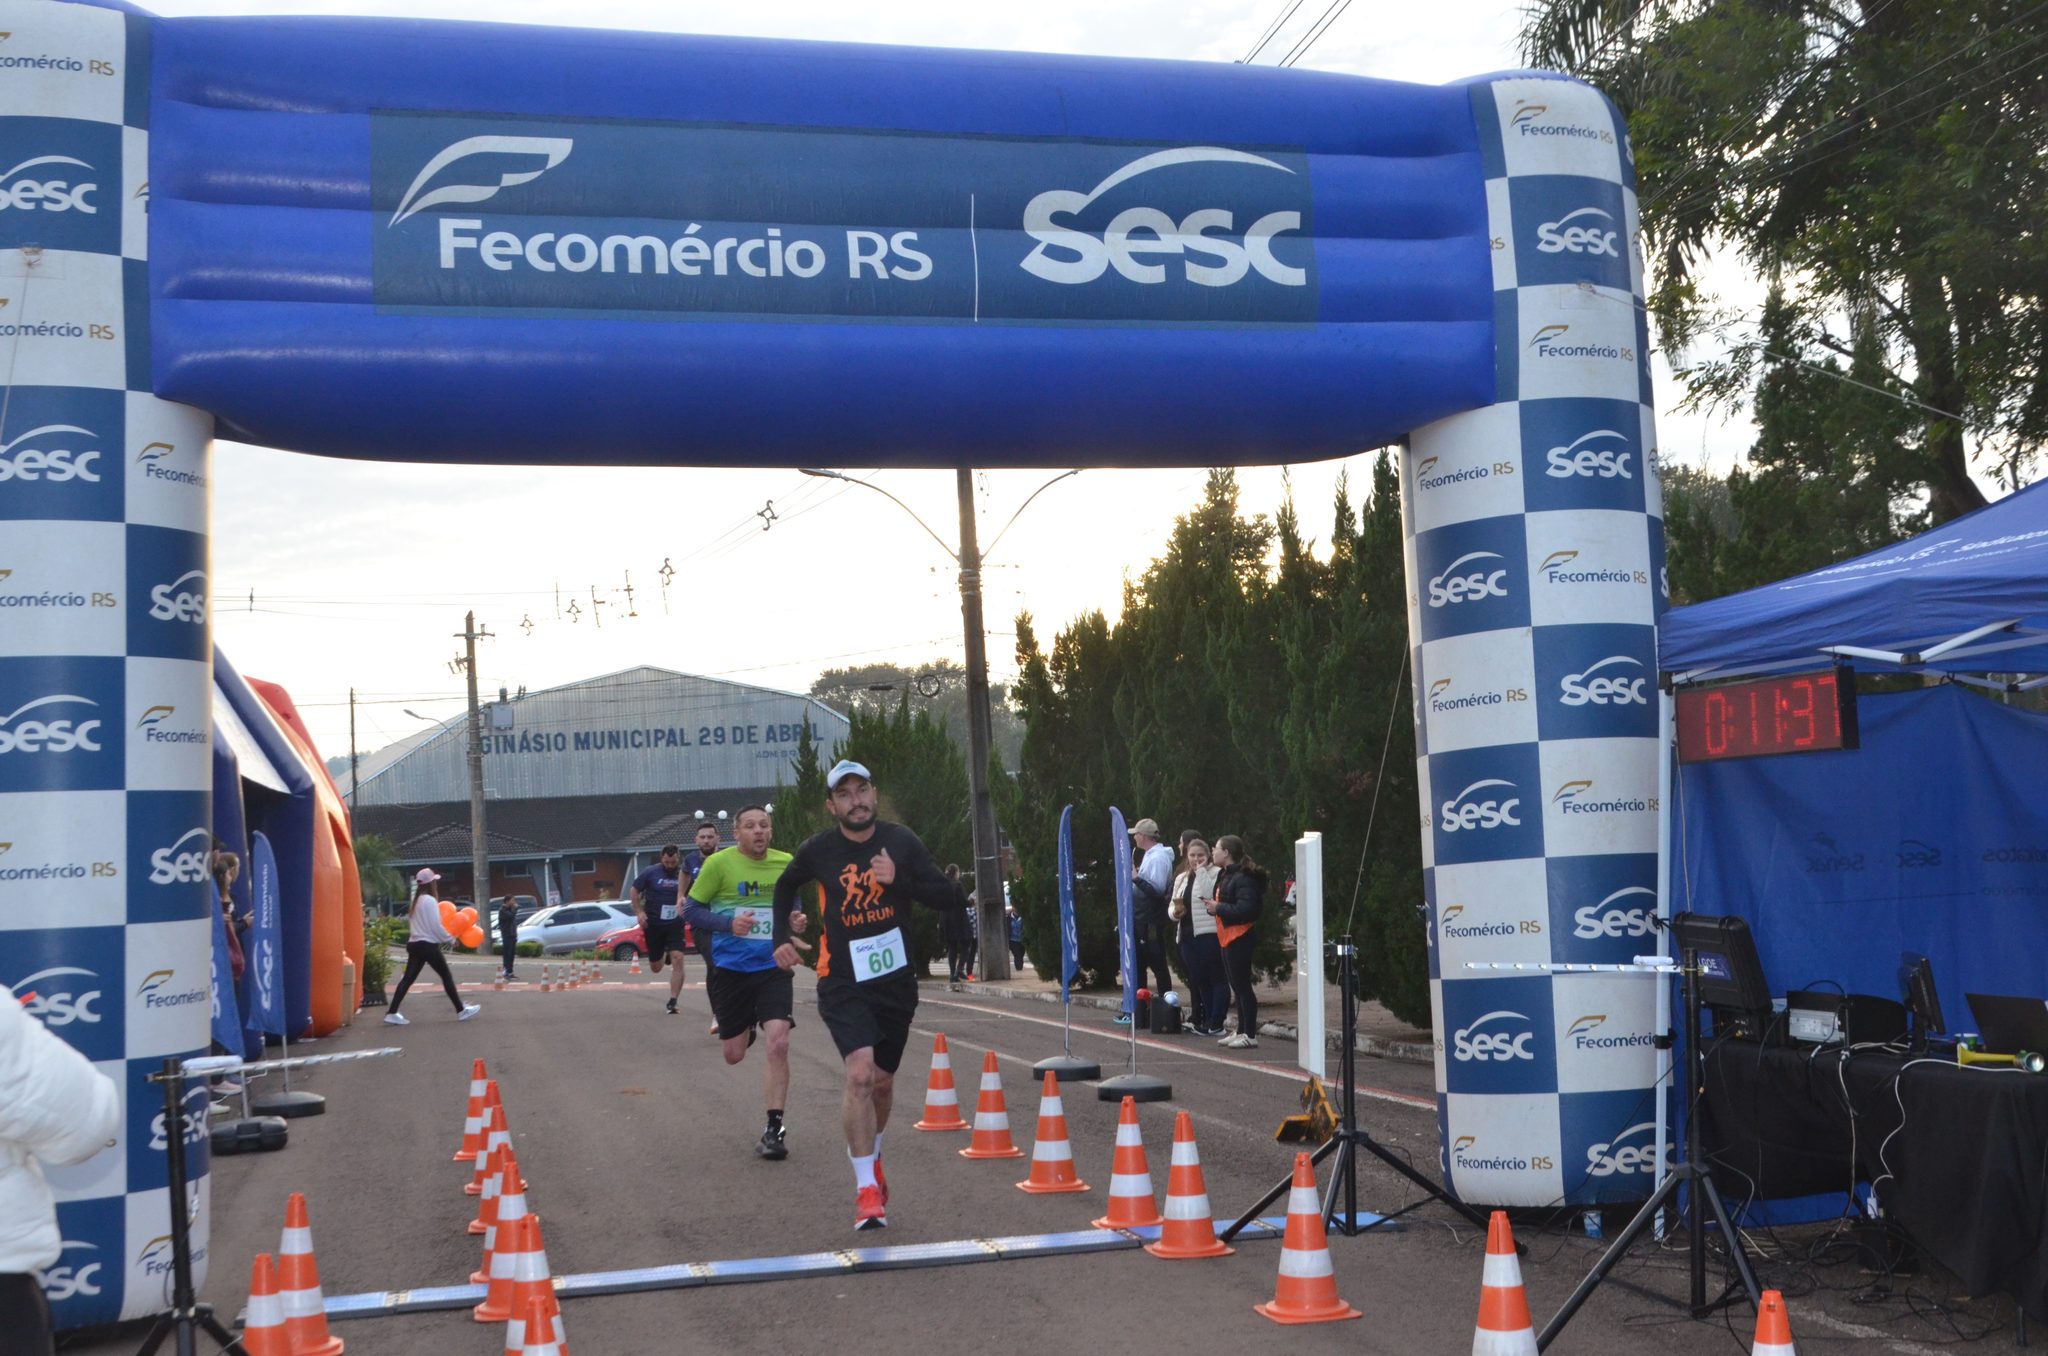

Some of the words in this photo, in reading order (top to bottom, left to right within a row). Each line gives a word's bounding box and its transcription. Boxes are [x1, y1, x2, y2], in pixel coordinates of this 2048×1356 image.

[89, 59, 115, 76] RS
[1521, 123, 1598, 140] Fecomércio
[1599, 130, 1614, 145] RS
[1020, 146, 1307, 287] Sesc
[1537, 207, 1619, 258] Sesc
[438, 217, 826, 278] Fecomércio
[847, 229, 933, 281] RS
[89, 324, 115, 340] RS
[1538, 344, 1618, 359] Fecomércio
[1620, 347, 1634, 362] RS
[1545, 429, 1633, 480] Sesc
[1419, 465, 1489, 492] Fecomércio
[1493, 461, 1514, 475] RS
[1428, 551, 1508, 608] Sesc
[1548, 568, 1630, 583] Fecomércio
[1633, 570, 1648, 584] RS
[91, 592, 116, 607] RS
[1559, 655, 1648, 706] Sesc
[1432, 692, 1502, 713] Fecomércio
[1506, 688, 1528, 703] RS
[481, 729, 567, 755] GINÁSIO
[573, 728, 692, 751] MUNICIPAL
[699, 726, 726, 746] 29
[732, 724, 758, 744] DE
[1440, 778, 1521, 833] Sesc
[1562, 798, 1645, 814] Fecomércio
[91, 862, 117, 877] RS
[841, 911, 864, 928] VM
[866, 906, 895, 923] RUN
[1445, 922, 1515, 938] Fecomércio
[1519, 920, 1541, 934] RS
[868, 947, 894, 974] 60
[1454, 1010, 1534, 1062] Sesc
[1456, 1156, 1527, 1171] Fecomércio
[1531, 1156, 1553, 1170] RS
